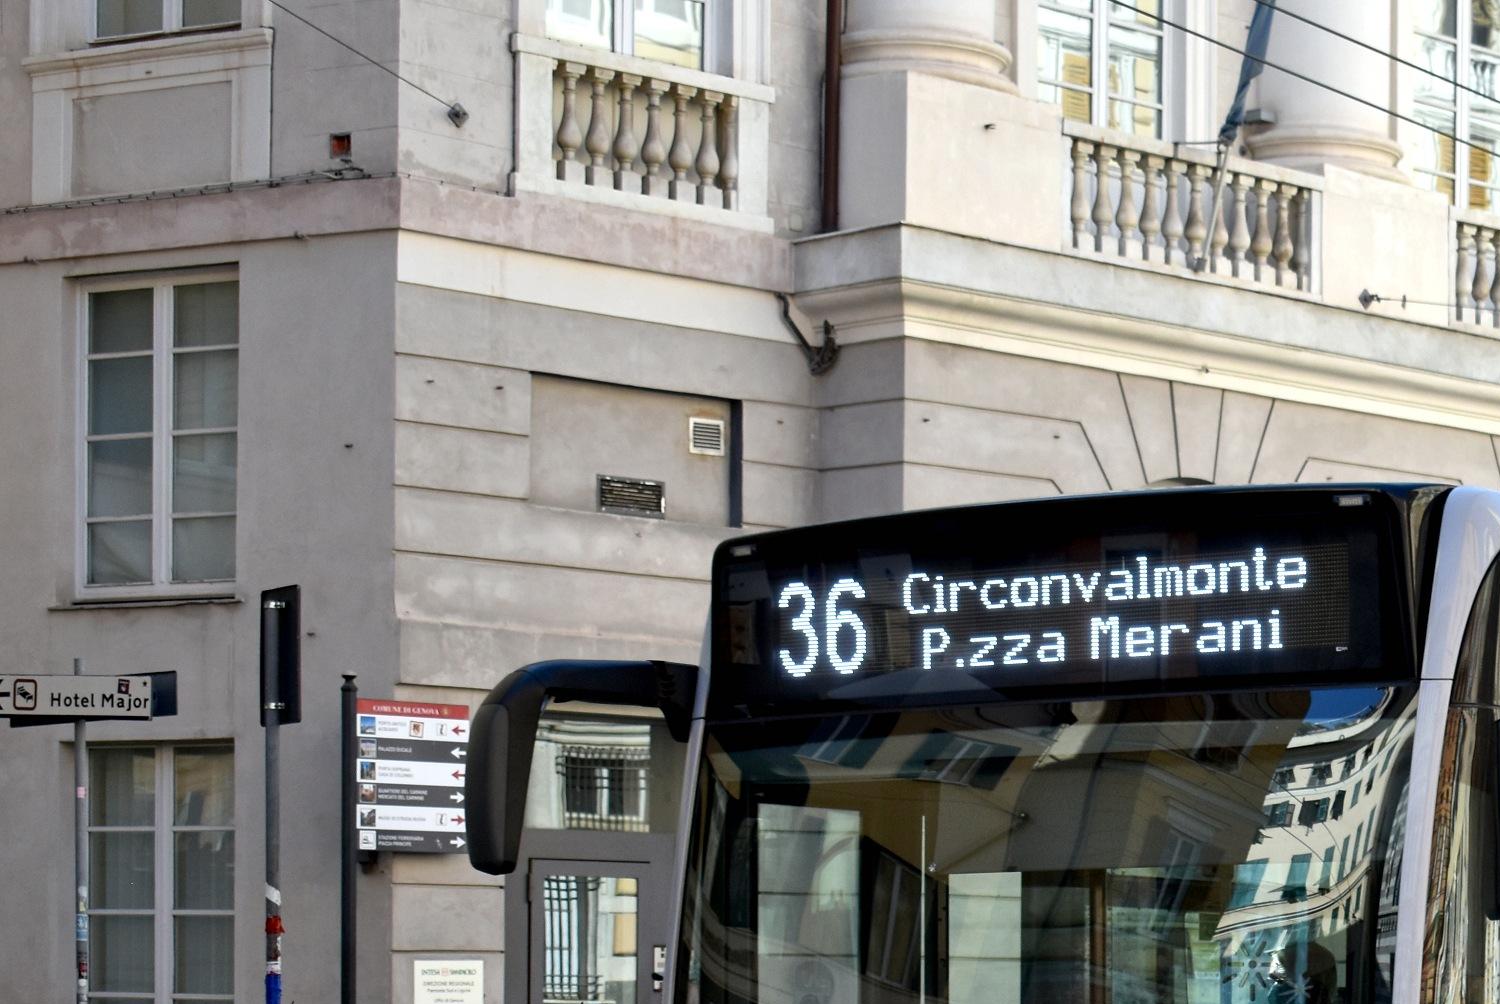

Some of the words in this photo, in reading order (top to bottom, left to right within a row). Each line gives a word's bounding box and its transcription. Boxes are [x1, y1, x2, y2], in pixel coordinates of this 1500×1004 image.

[902, 547, 1308, 615] Circonvalmonte
[778, 577, 868, 677] 36
[922, 627, 1065, 670] P.zza
[1090, 609, 1283, 660] Merani
[51, 692, 95, 708] Hotel
[101, 693, 150, 712] Major
[373, 705, 401, 713] COMUNE
[412, 708, 439, 716] GENOVA
